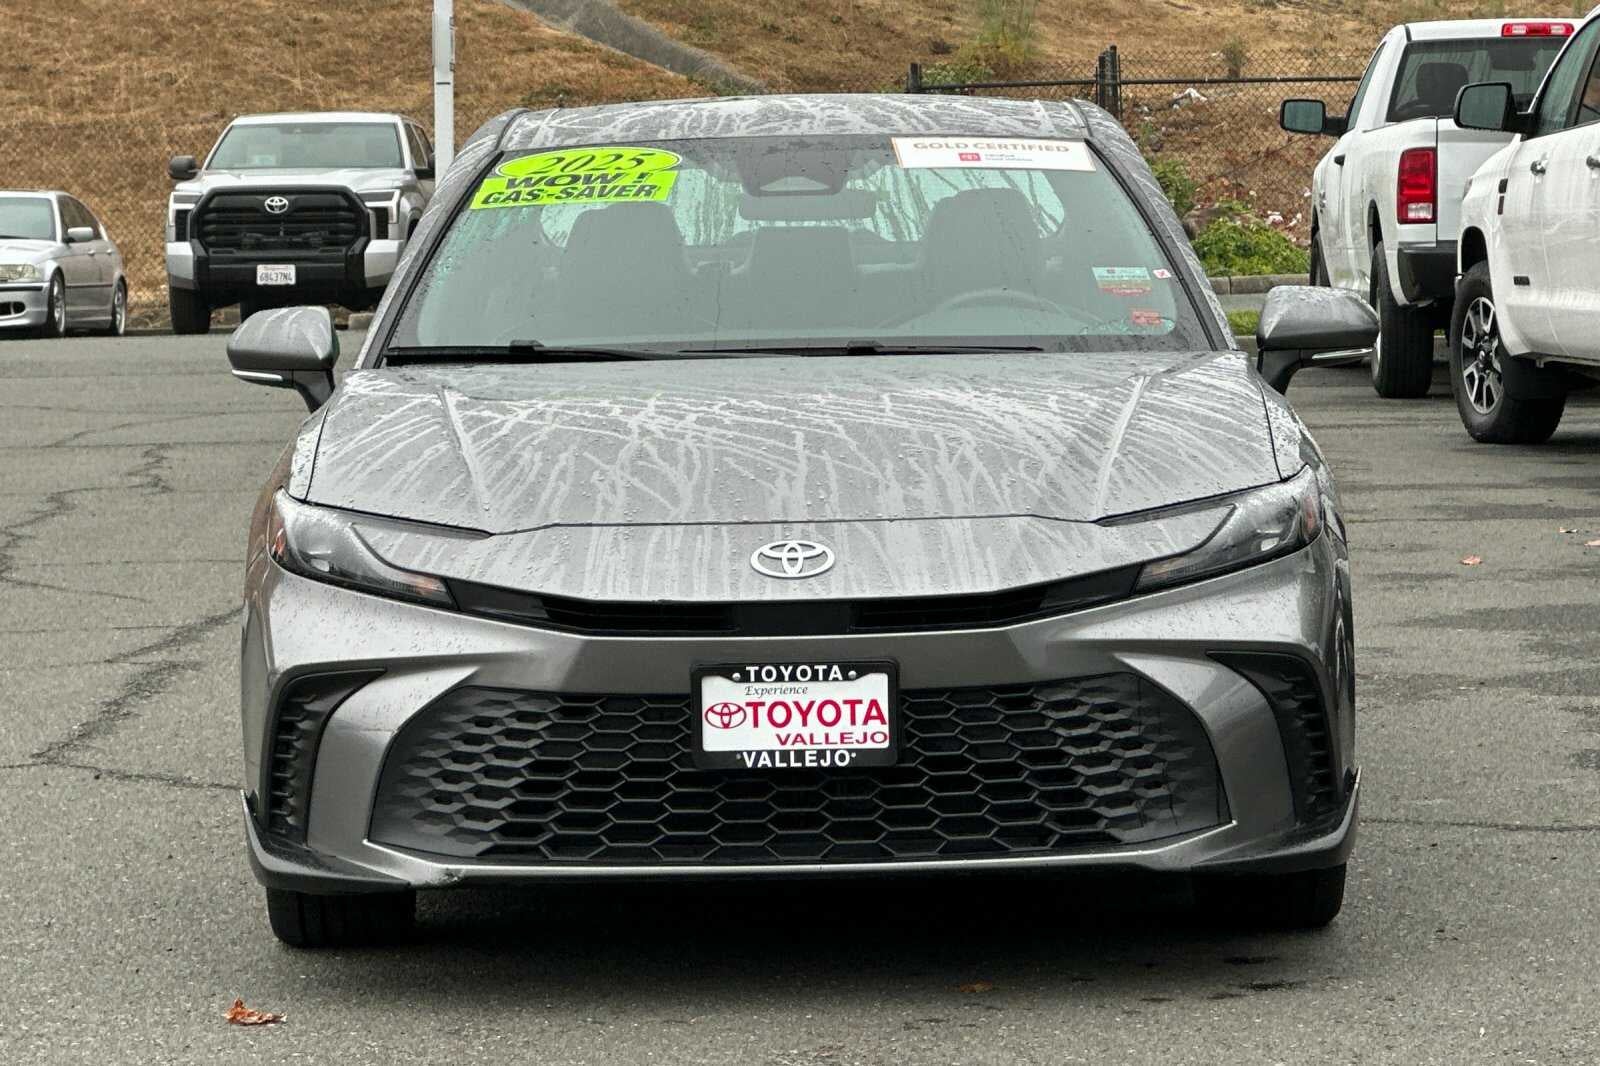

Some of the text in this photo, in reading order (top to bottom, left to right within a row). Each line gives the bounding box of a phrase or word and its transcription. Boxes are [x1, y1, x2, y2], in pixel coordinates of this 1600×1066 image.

[913, 142, 1070, 153] GOLD CERTIFIED
[530, 152, 657, 175] 2025
[480, 184, 660, 205] GAS-SAVER
[746, 665, 843, 682] TOYOTA
[744, 685, 809, 698] Experience
[745, 699, 888, 729] TOYOTA
[775, 731, 889, 746] VALLEJO
[742, 749, 850, 768] VALLEJO
